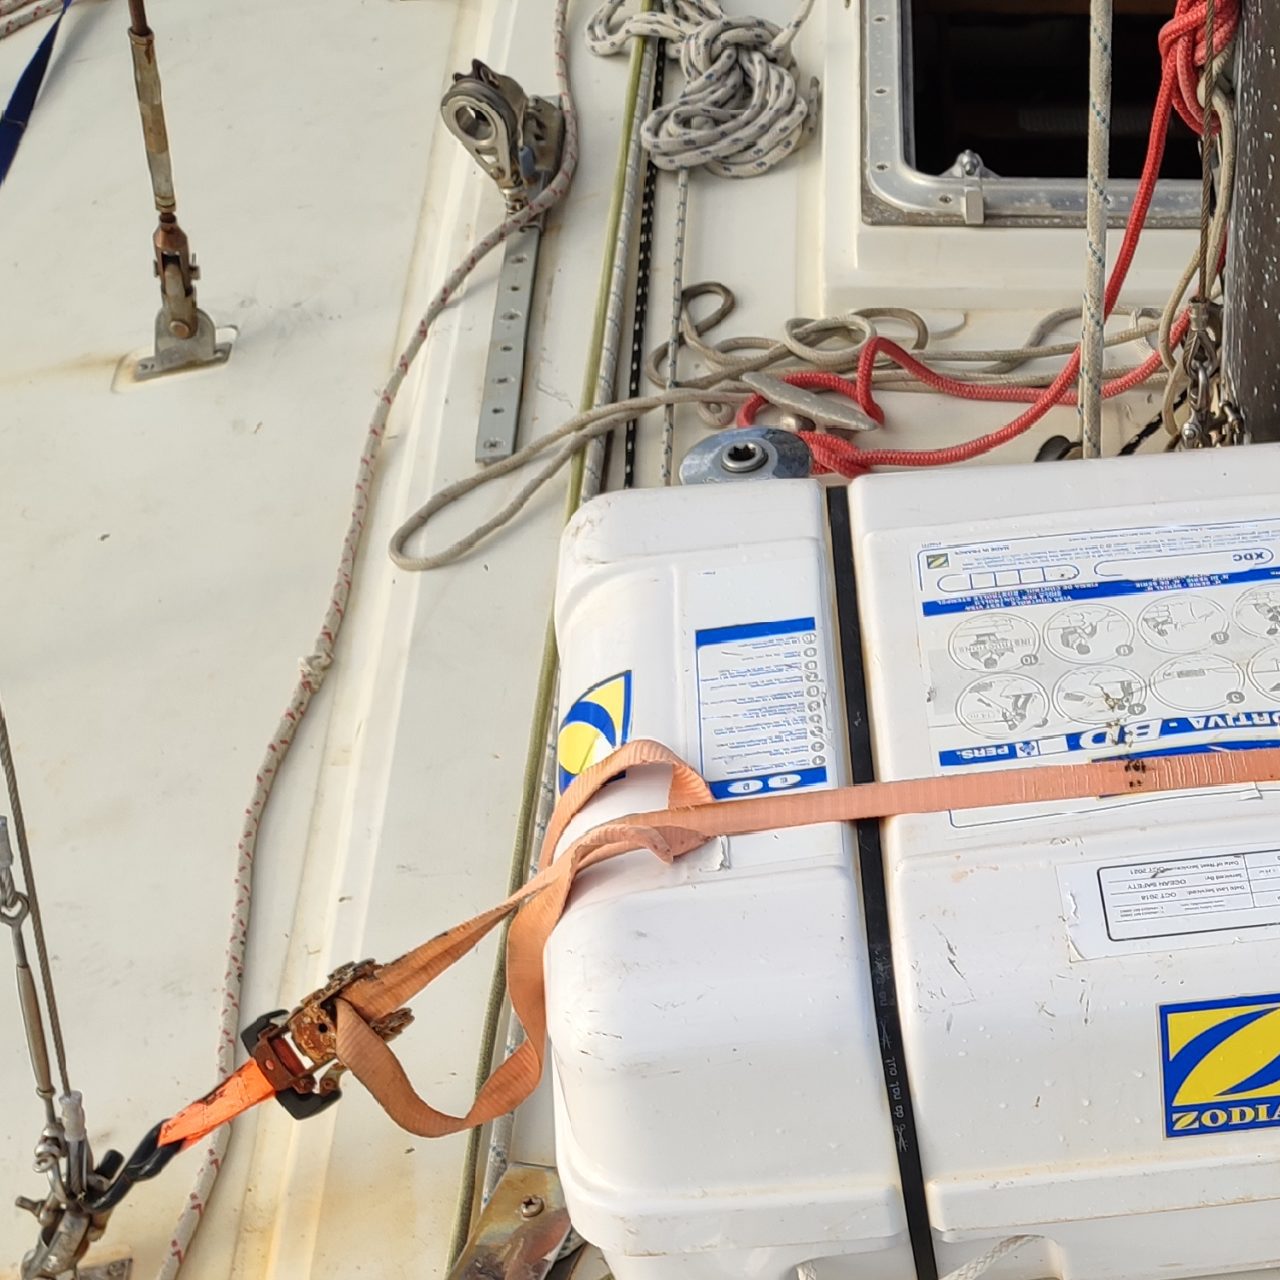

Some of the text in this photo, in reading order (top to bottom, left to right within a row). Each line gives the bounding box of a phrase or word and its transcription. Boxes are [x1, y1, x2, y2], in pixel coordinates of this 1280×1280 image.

[1232, 551, 1265, 562] XDC
[956, 745, 1009, 759] PERS.
[1127, 879, 1186, 889] OCEAN SAFETY
[1160, 891, 1177, 900] OCT
[884, 1056, 904, 1119] do not cut
